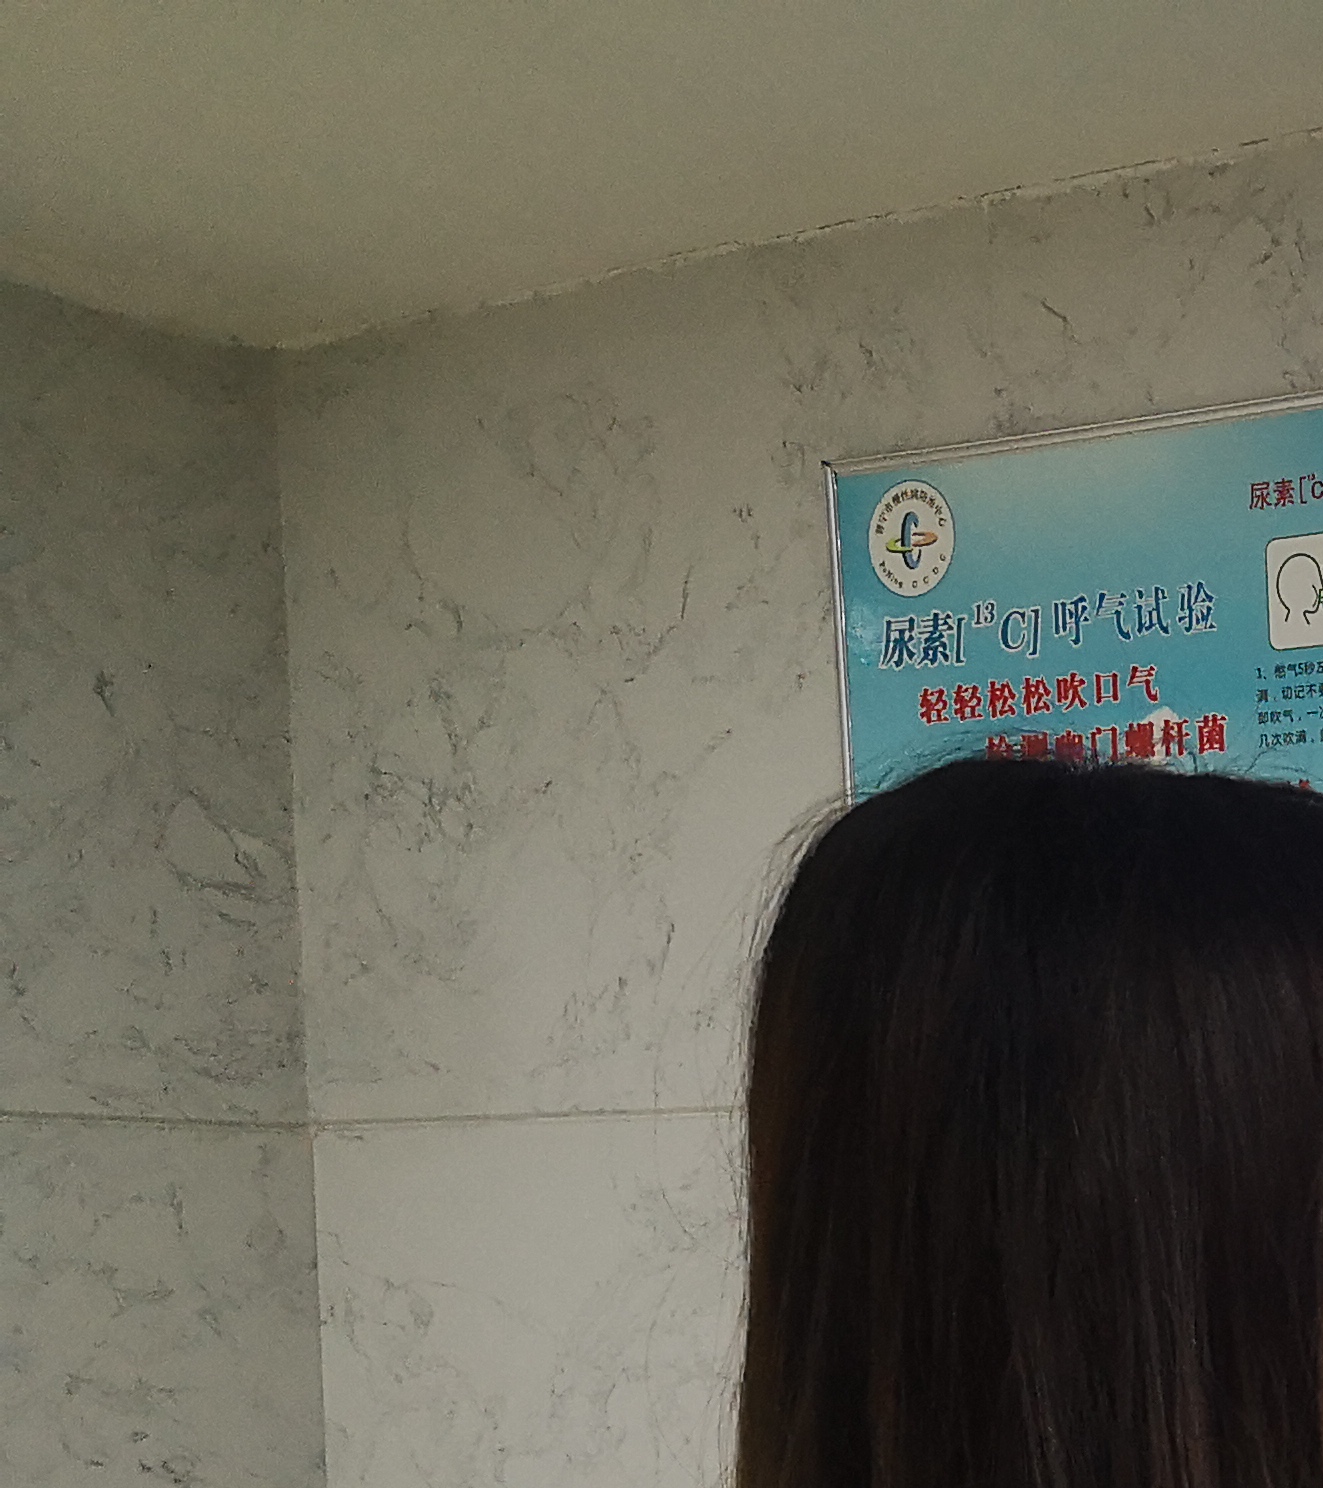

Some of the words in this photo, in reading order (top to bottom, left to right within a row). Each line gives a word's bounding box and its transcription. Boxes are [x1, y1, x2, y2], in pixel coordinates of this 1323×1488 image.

[919, 665, 1158, 725] 轻轻松松吹口气
